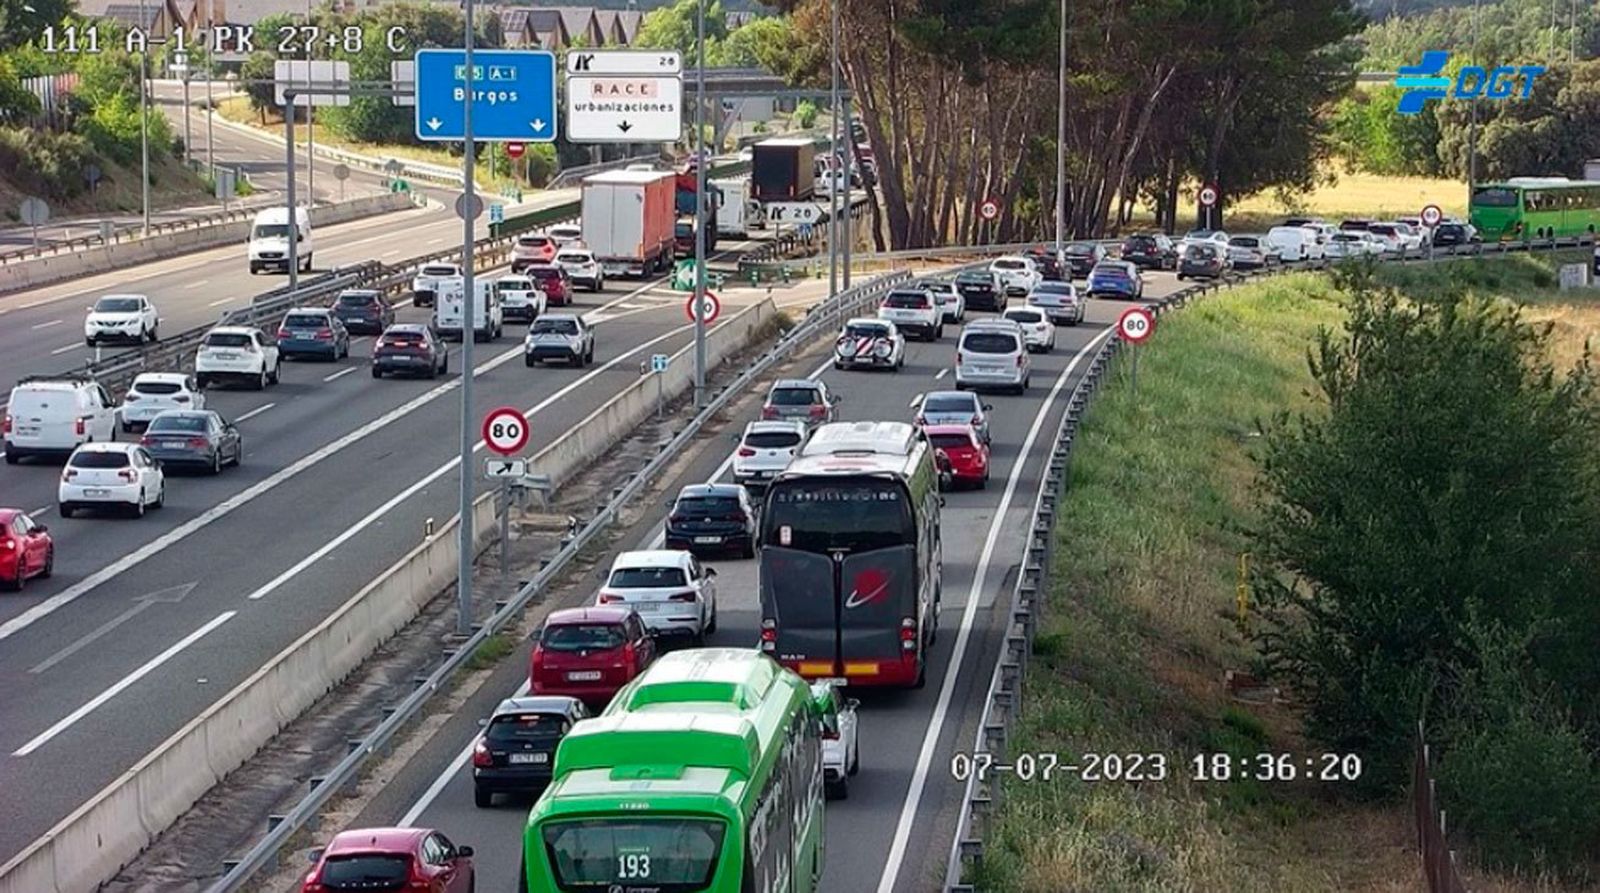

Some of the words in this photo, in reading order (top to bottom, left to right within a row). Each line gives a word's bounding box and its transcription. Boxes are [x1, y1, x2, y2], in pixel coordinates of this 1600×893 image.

[492, 66, 515, 79] A-1
[593, 83, 649, 94] RACE
[574, 102, 674, 112] urbanizaciones
[1126, 319, 1146, 331] 80
[492, 423, 520, 439] 80
[618, 854, 651, 878] 193
